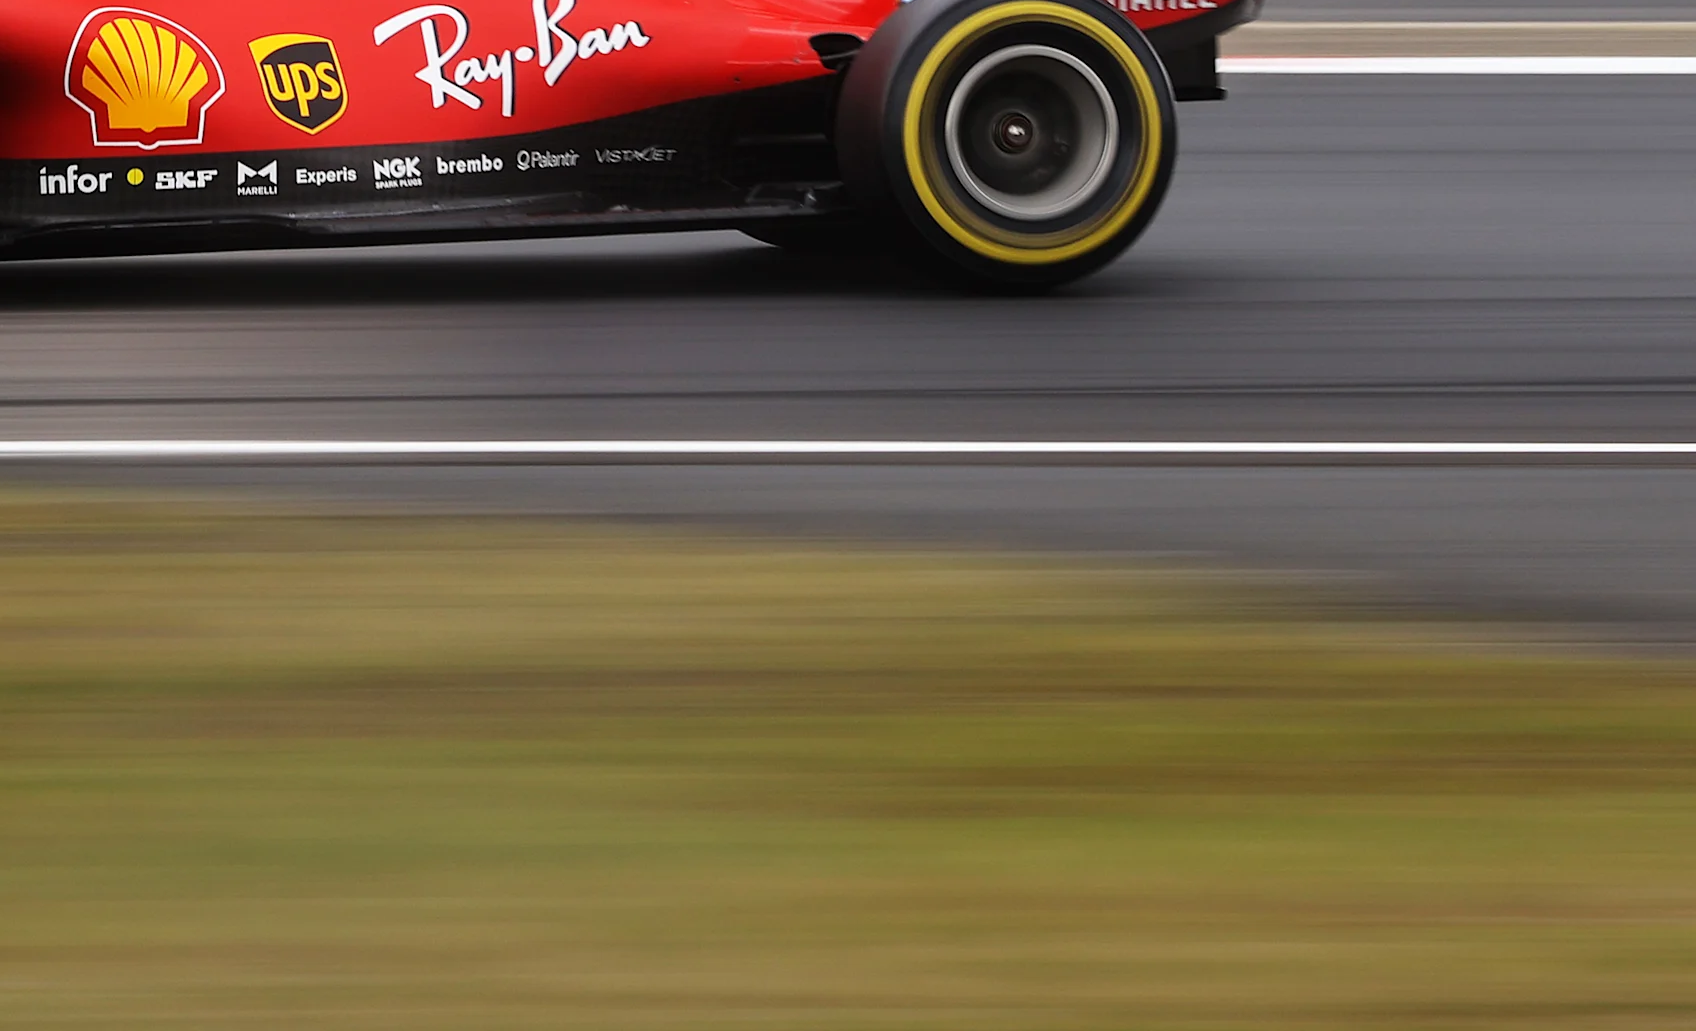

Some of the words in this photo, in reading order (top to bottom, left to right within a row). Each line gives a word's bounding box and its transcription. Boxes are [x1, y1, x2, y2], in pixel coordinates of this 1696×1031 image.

[262, 61, 342, 118] ups
[372, 155, 422, 180] NGK
[436, 153, 504, 175] brembo
[530, 148, 581, 169] Palantir
[39, 164, 113, 194] infor
[155, 169, 218, 190] SKF
[295, 166, 358, 187] Experis
[374, 179, 399, 190] SPARK
[399, 177, 423, 188] PLUGS
[237, 185, 278, 196] MARELLI
